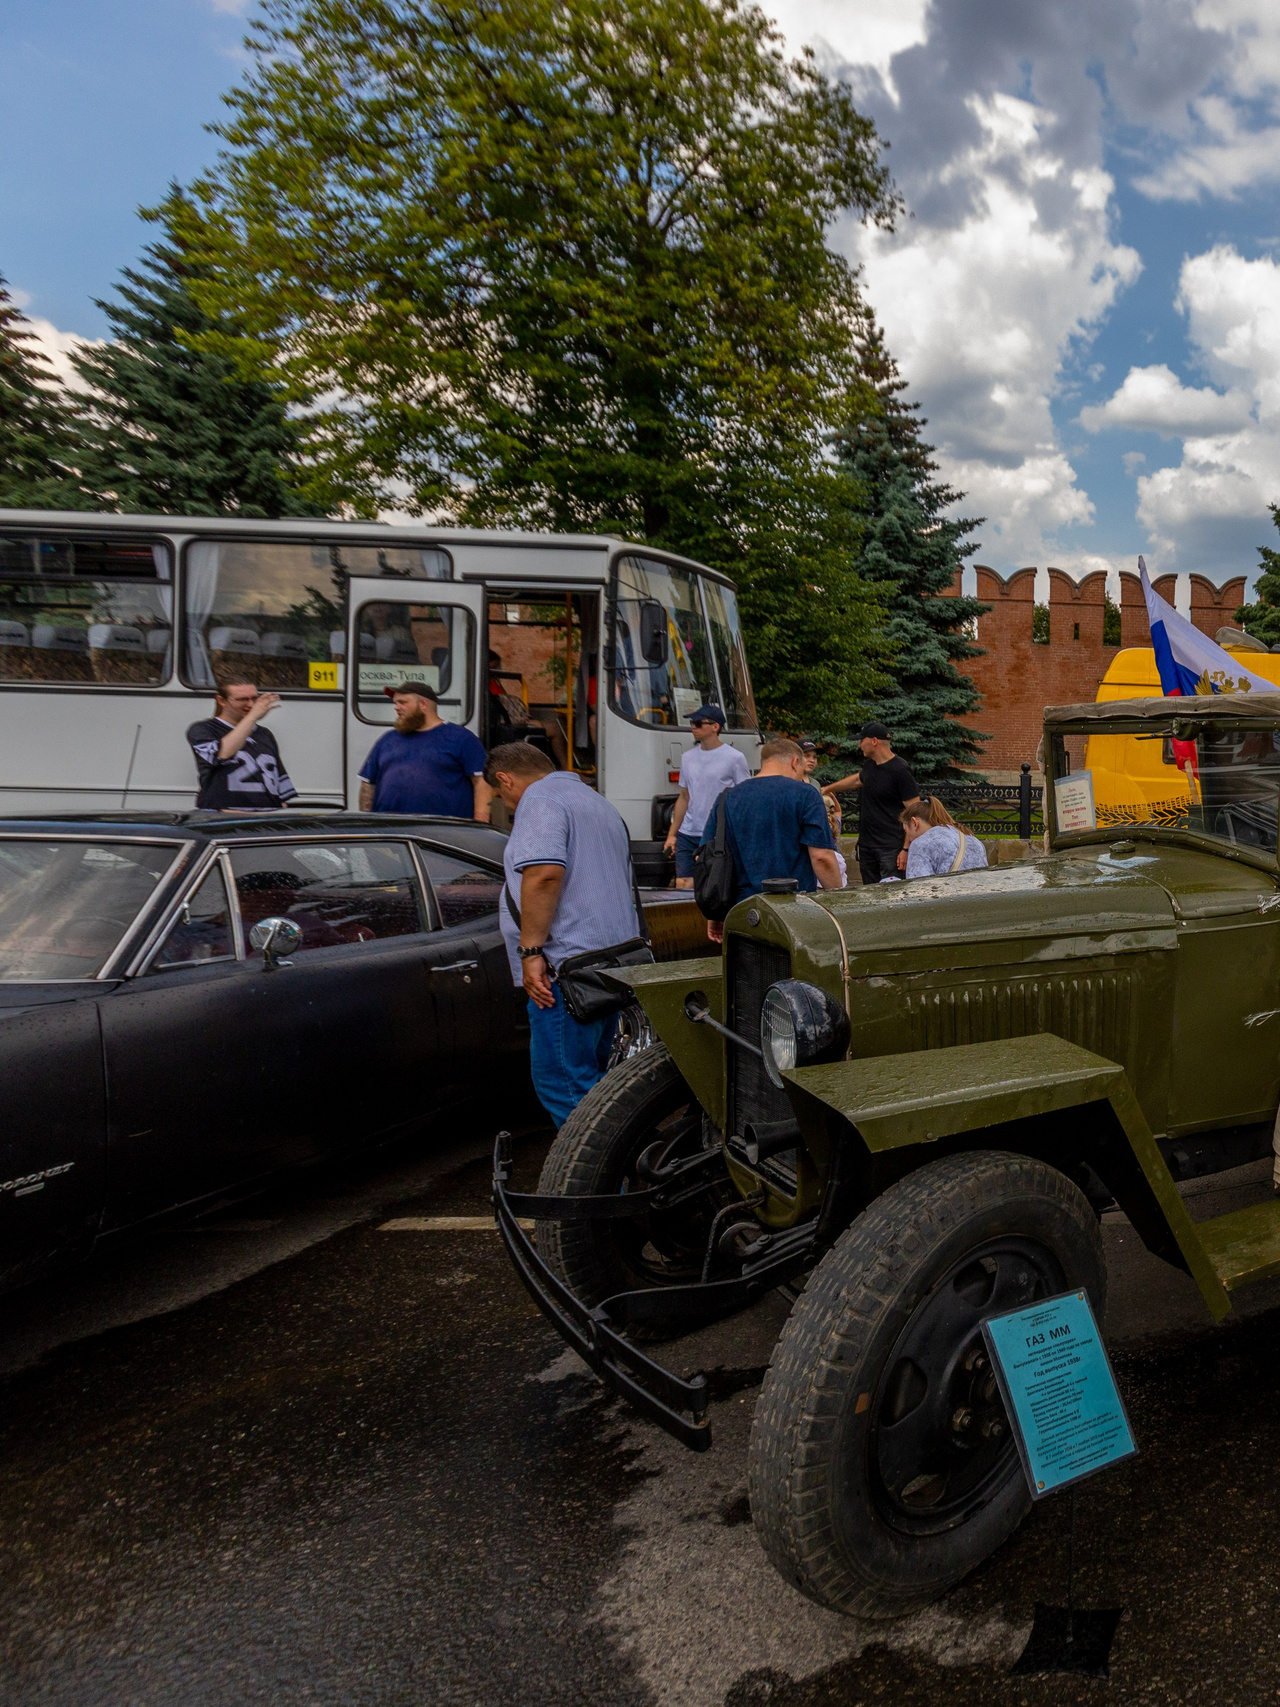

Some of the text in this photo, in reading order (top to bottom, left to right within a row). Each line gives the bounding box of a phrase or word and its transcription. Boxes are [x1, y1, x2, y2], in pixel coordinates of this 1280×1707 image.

[313, 670, 334, 682] 911
[359, 669, 426, 683] осква-Тула
[0, 1161, 76, 1192] ORONET
[1026, 1324, 1071, 1348] ГАЗ ММ
[1034, 1370, 1045, 1378] Год
[1045, 1363, 1067, 1374] выпуска
